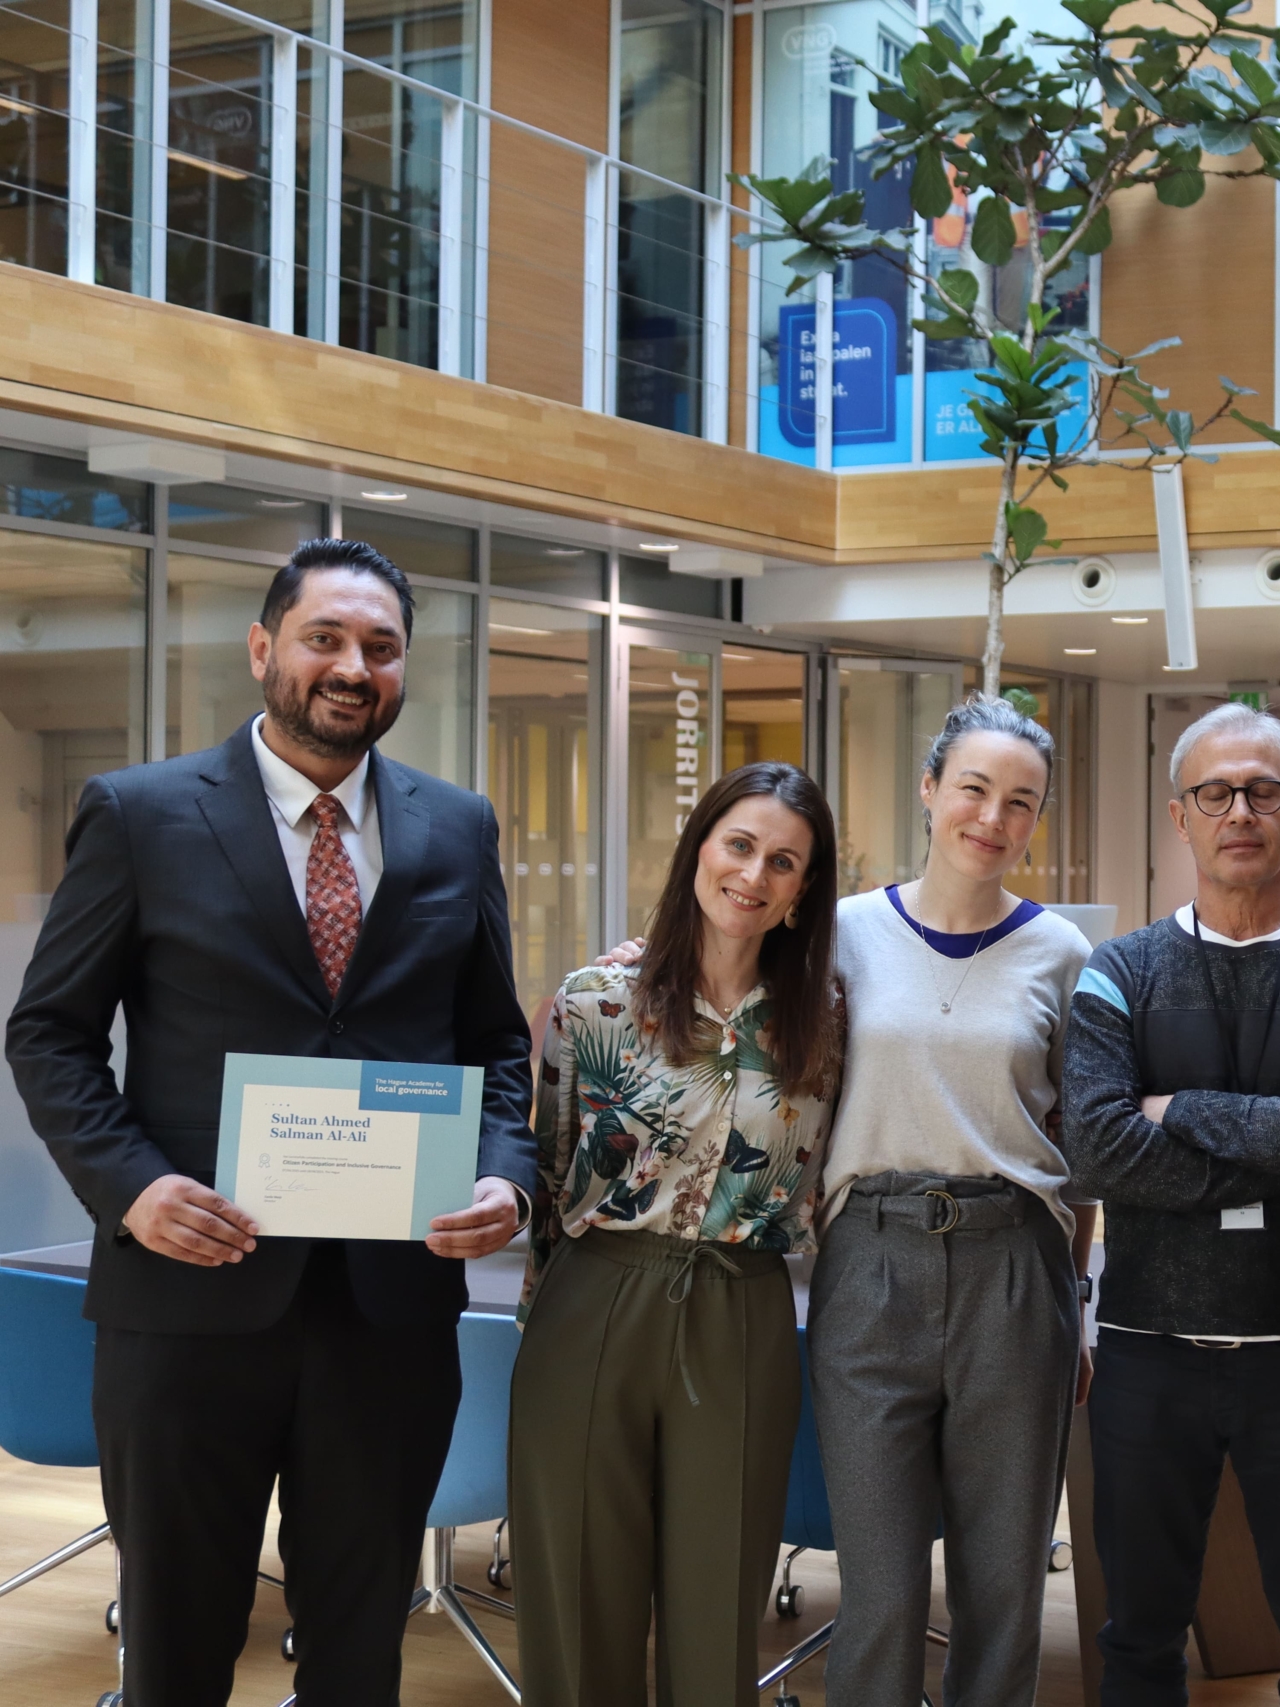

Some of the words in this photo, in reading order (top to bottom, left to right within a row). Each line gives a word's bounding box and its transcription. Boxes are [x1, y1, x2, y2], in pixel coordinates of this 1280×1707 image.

[801, 366, 814, 380] in
[936, 404, 953, 418] JE
[936, 421, 954, 434] ER
[375, 1085, 396, 1093] local
[398, 1086, 448, 1096] governance
[388, 1079, 406, 1087] Hague
[409, 1080, 434, 1088] Academy
[271, 1113, 317, 1126] Sultan
[321, 1115, 370, 1128] Ahmed
[270, 1128, 323, 1141] Salman
[327, 1130, 367, 1142] Al-Ali
